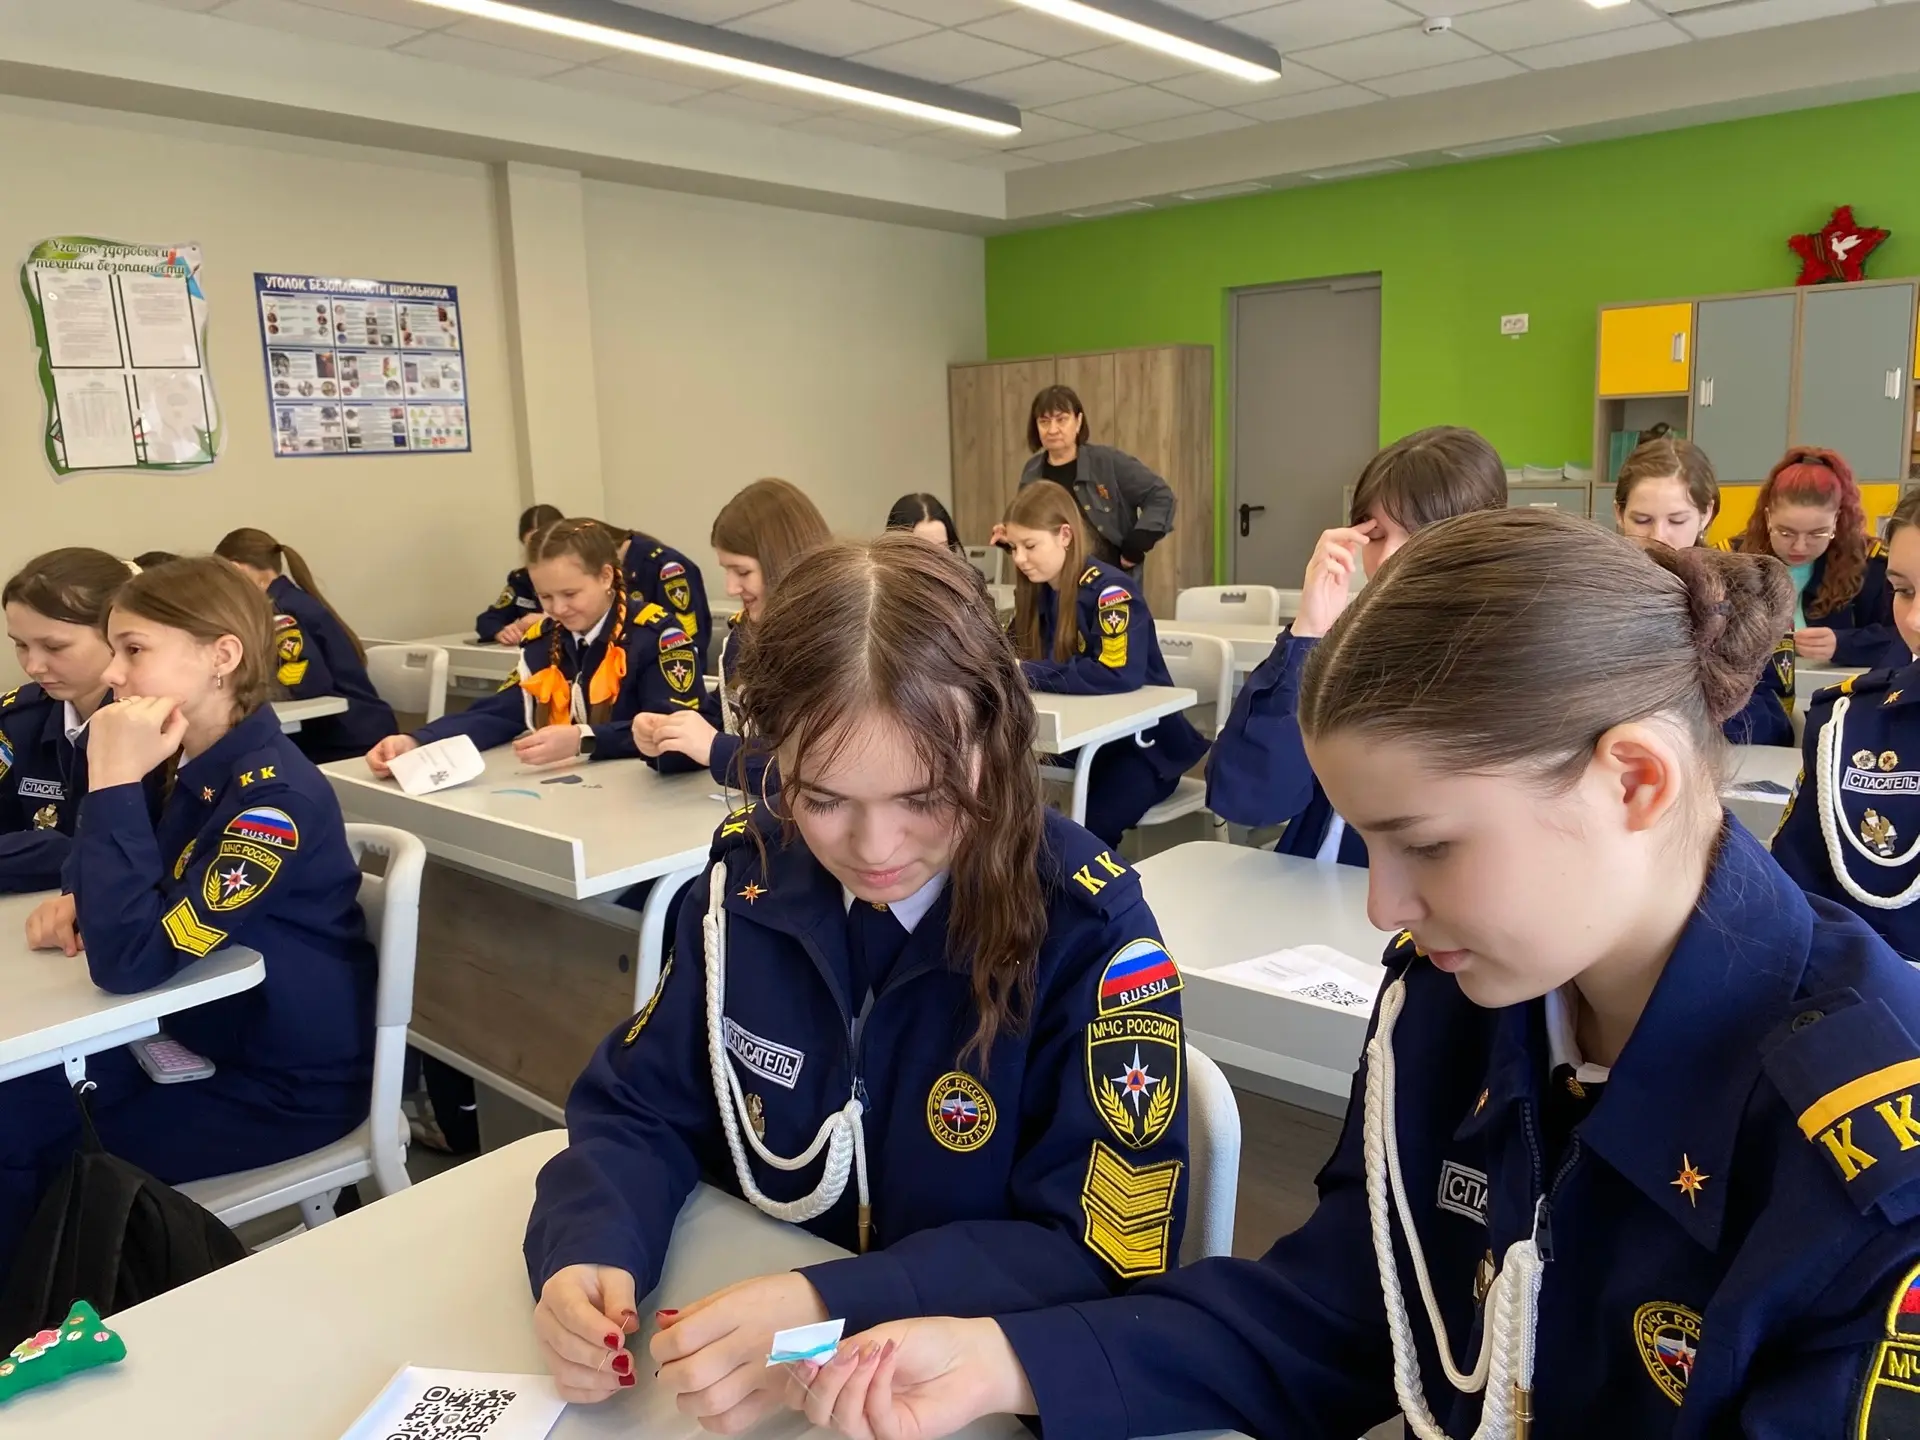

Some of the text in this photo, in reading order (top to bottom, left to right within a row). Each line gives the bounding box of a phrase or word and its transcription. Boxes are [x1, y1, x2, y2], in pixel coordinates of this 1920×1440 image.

[49, 239, 97, 254] Уголок
[36, 258, 185, 275] техники безопасности
[265, 276, 307, 291] УГОЛОК
[390, 284, 450, 299] ШКОЛЬНИКА
[1850, 774, 1917, 789] СПАСАТЕЛЬ
[241, 828, 283, 845] RUSSIA
[224, 844, 278, 868] МЧС РОССИИ
[1120, 979, 1169, 1005] RUSSIA
[1092, 1019, 1175, 1040] МЧС РОССИИ
[729, 1028, 793, 1078] СПАСАТЕЛЬ
[936, 1079, 988, 1111] МЧС РОССИИ
[934, 1114, 988, 1145] СПАСАТЕЛЬ
